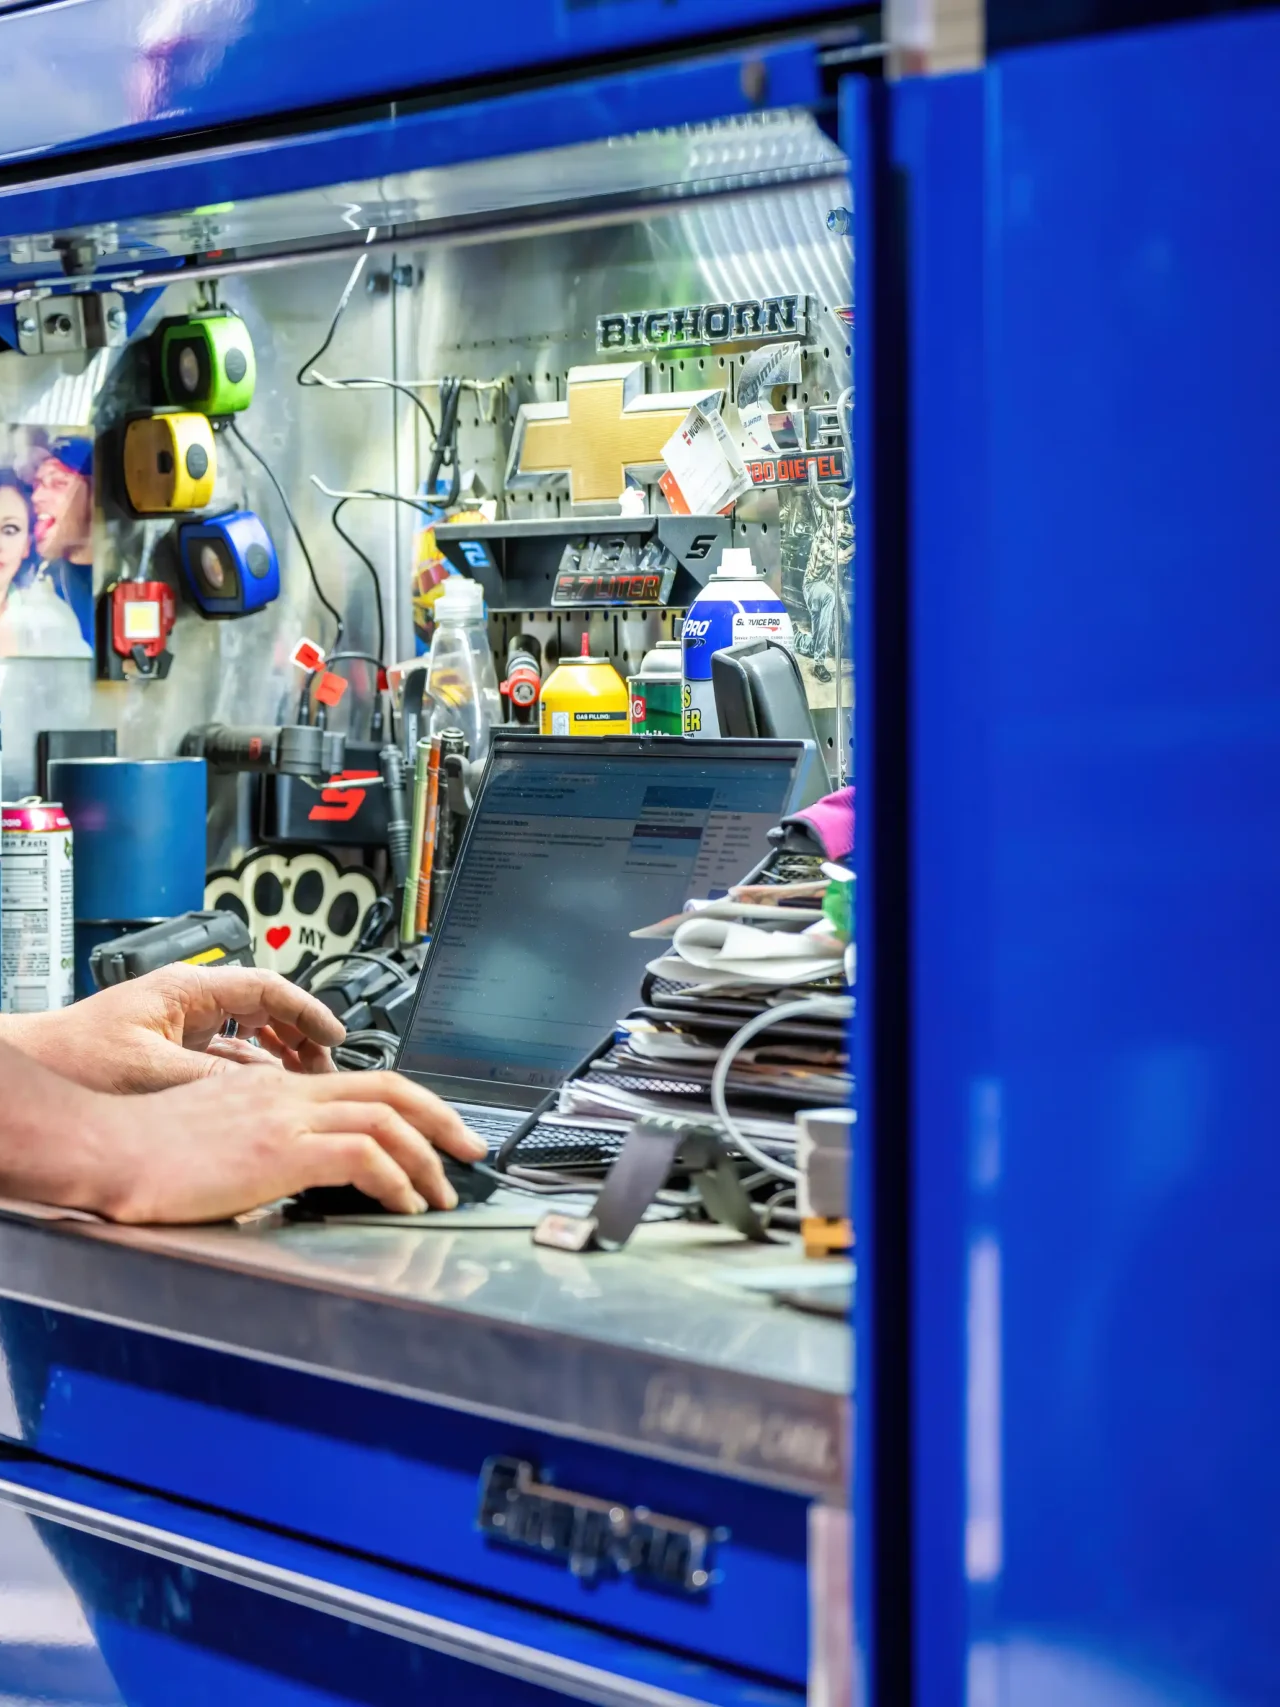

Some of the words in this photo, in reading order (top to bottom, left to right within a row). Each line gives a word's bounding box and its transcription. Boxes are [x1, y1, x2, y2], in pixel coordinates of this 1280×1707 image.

[598, 296, 799, 351] BIGHORN
[595, 575, 660, 599] LITER
[767, 618, 781, 626] PRO
[575, 713, 588, 721] GAS
[299, 926, 326, 951] MY
